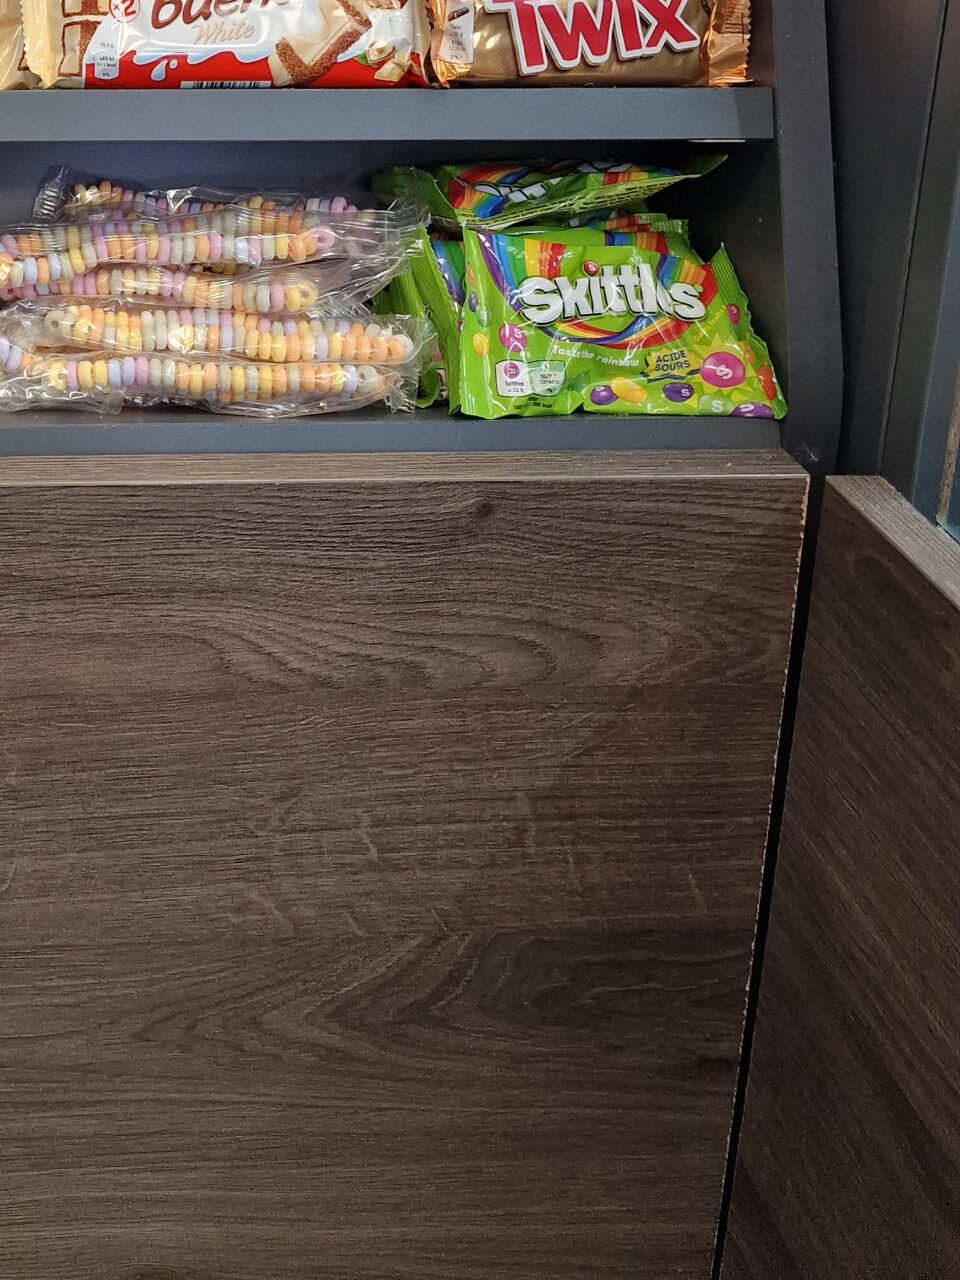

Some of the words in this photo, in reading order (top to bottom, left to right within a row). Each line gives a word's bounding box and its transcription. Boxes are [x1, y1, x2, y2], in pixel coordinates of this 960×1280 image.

[192, 23, 256, 46] White
[551, 344, 581, 357] Taste
[596, 353, 640, 367] rainbow
[655, 349, 688, 363] ACIDE
[655, 359, 691, 372] SOURS
